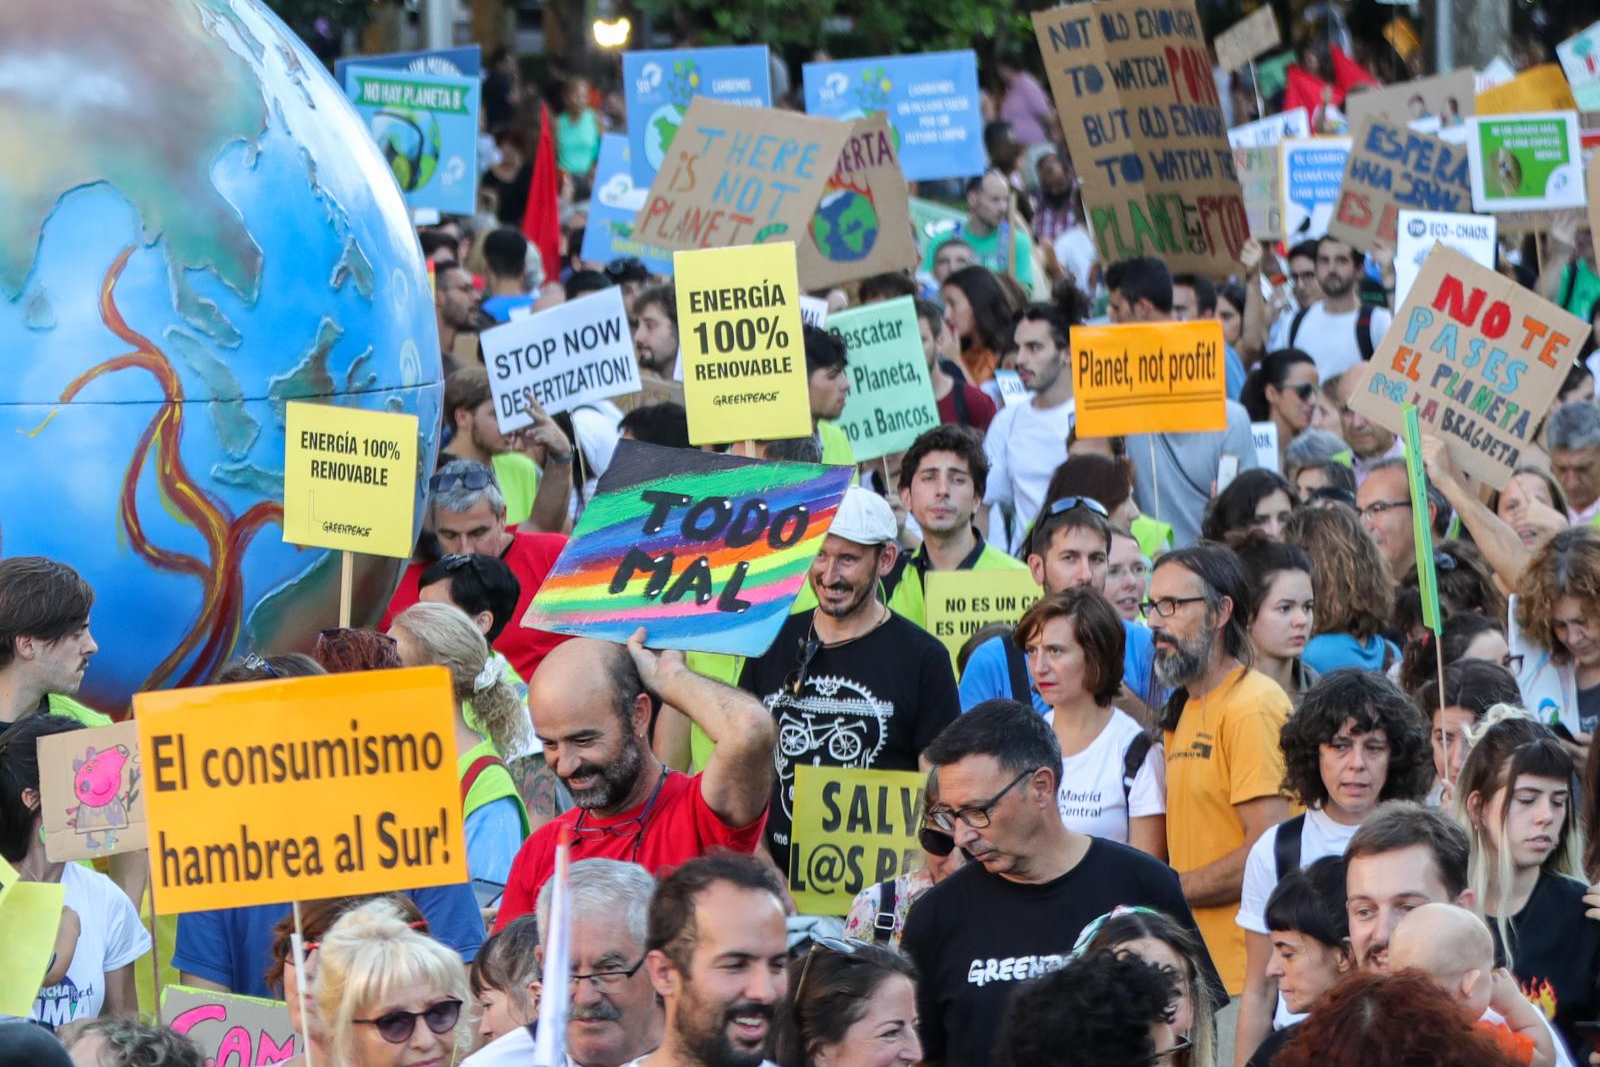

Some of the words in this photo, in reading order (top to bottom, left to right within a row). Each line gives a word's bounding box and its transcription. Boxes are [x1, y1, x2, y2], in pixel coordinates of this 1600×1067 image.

[1048, 18, 1091, 54] NOT
[1101, 11, 1130, 43] OLD
[364, 82, 379, 102] NO
[382, 84, 400, 104] HAY
[403, 86, 450, 109] PLANETA
[1064, 65, 1104, 97] TO
[1106, 55, 1168, 90] WATCH
[1083, 109, 1131, 147] BUT
[1138, 108, 1168, 139] OLD
[697, 127, 821, 179] THERE
[840, 131, 894, 173] ERTA
[1094, 154, 1144, 186] TO
[1149, 148, 1212, 182] WATCH
[710, 171, 800, 219] NOT
[640, 197, 753, 248] PLANET
[689, 279, 786, 314] ENERGÍA
[693, 315, 789, 356] 100%
[1431, 273, 1511, 339] NO
[1521, 315, 1570, 369] TE
[495, 338, 556, 380] STOP
[563, 317, 620, 357] NOW
[695, 357, 792, 381] RENOVABLE
[1079, 349, 1133, 392] Planet,
[1138, 346, 1164, 383] not
[1169, 342, 1216, 392] profit!
[1403, 306, 1528, 395] PASES
[500, 355, 632, 418] DESERTIZATION!
[853, 361, 921, 394] Planeta,
[1391, 345, 1423, 382] EL
[1430, 363, 1531, 440] PLANETA
[713, 391, 779, 407] GREENPEACE
[1368, 372, 1408, 404] POR
[1440, 407, 1521, 467] BRAGUETA
[863, 422, 873, 438] a
[874, 404, 934, 434] Bancos.
[301, 430, 357, 455] ENERGÍA
[363, 438, 400, 460] 100%
[310, 459, 388, 486] RENOVABLE
[322, 521, 372, 537] GREENPEACE
[640, 490, 810, 550] TODO
[608, 544, 751, 613] MAL
[946, 598, 966, 613] NO
[971, 597, 990, 612] ES
[995, 596, 1015, 611] UN
[936, 621, 954, 636] ES
[960, 619, 988, 635] UN
[151, 734, 188, 792] El
[202, 719, 443, 789] consumismo
[822, 781, 923, 838] SALV
[1061, 790, 1101, 803] Madrid
[158, 824, 323, 887] hambrea
[334, 815, 364, 873] al
[376, 807, 450, 869] Sur!
[790, 843, 864, 895] L@S
[967, 954, 1074, 987] GREENP
